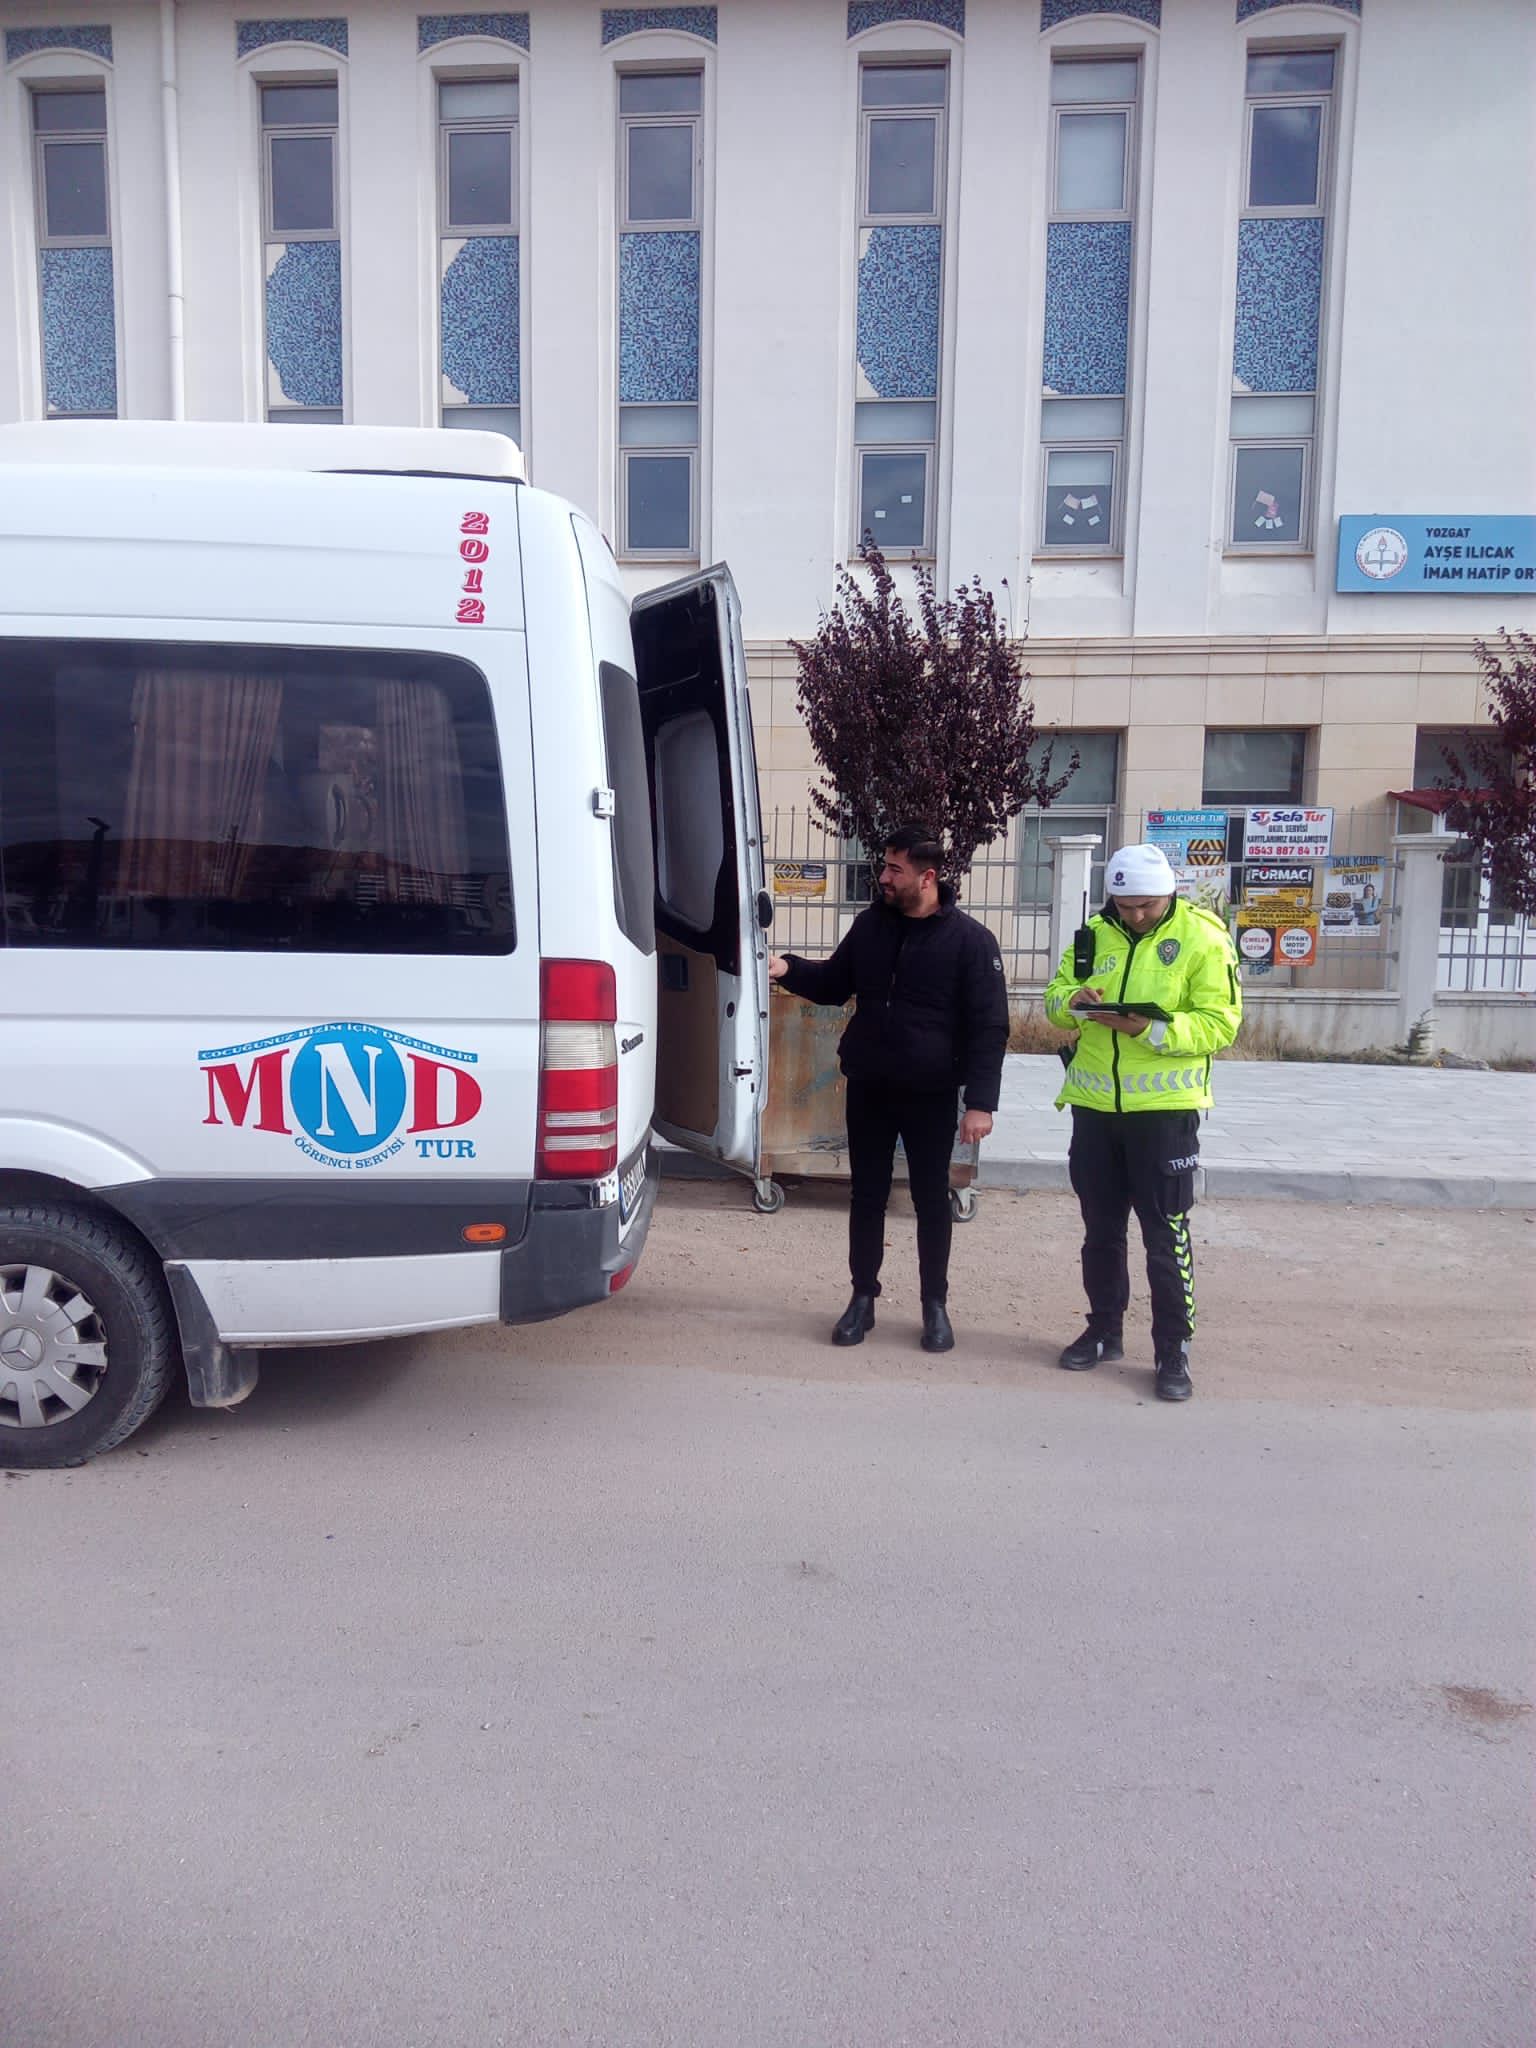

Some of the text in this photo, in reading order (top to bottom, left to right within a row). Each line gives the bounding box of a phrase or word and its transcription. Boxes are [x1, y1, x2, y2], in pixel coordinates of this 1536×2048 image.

[1426, 528, 1471, 538] YOZGAT
[1424, 546, 1515, 561] AYŞE ILICAK
[455, 511, 489, 624] 2012
[1423, 564, 1536, 579] İMAM HATİP OR
[1272, 810, 1327, 822] Sefa Tur
[1248, 846, 1273, 855] 0543
[1314, 846, 1326, 855] 17
[200, 1042, 482, 1136] MND
[294, 1135, 406, 1169] ÖĞRENCİ SERVİSİ
[415, 1139, 477, 1158] TUR
